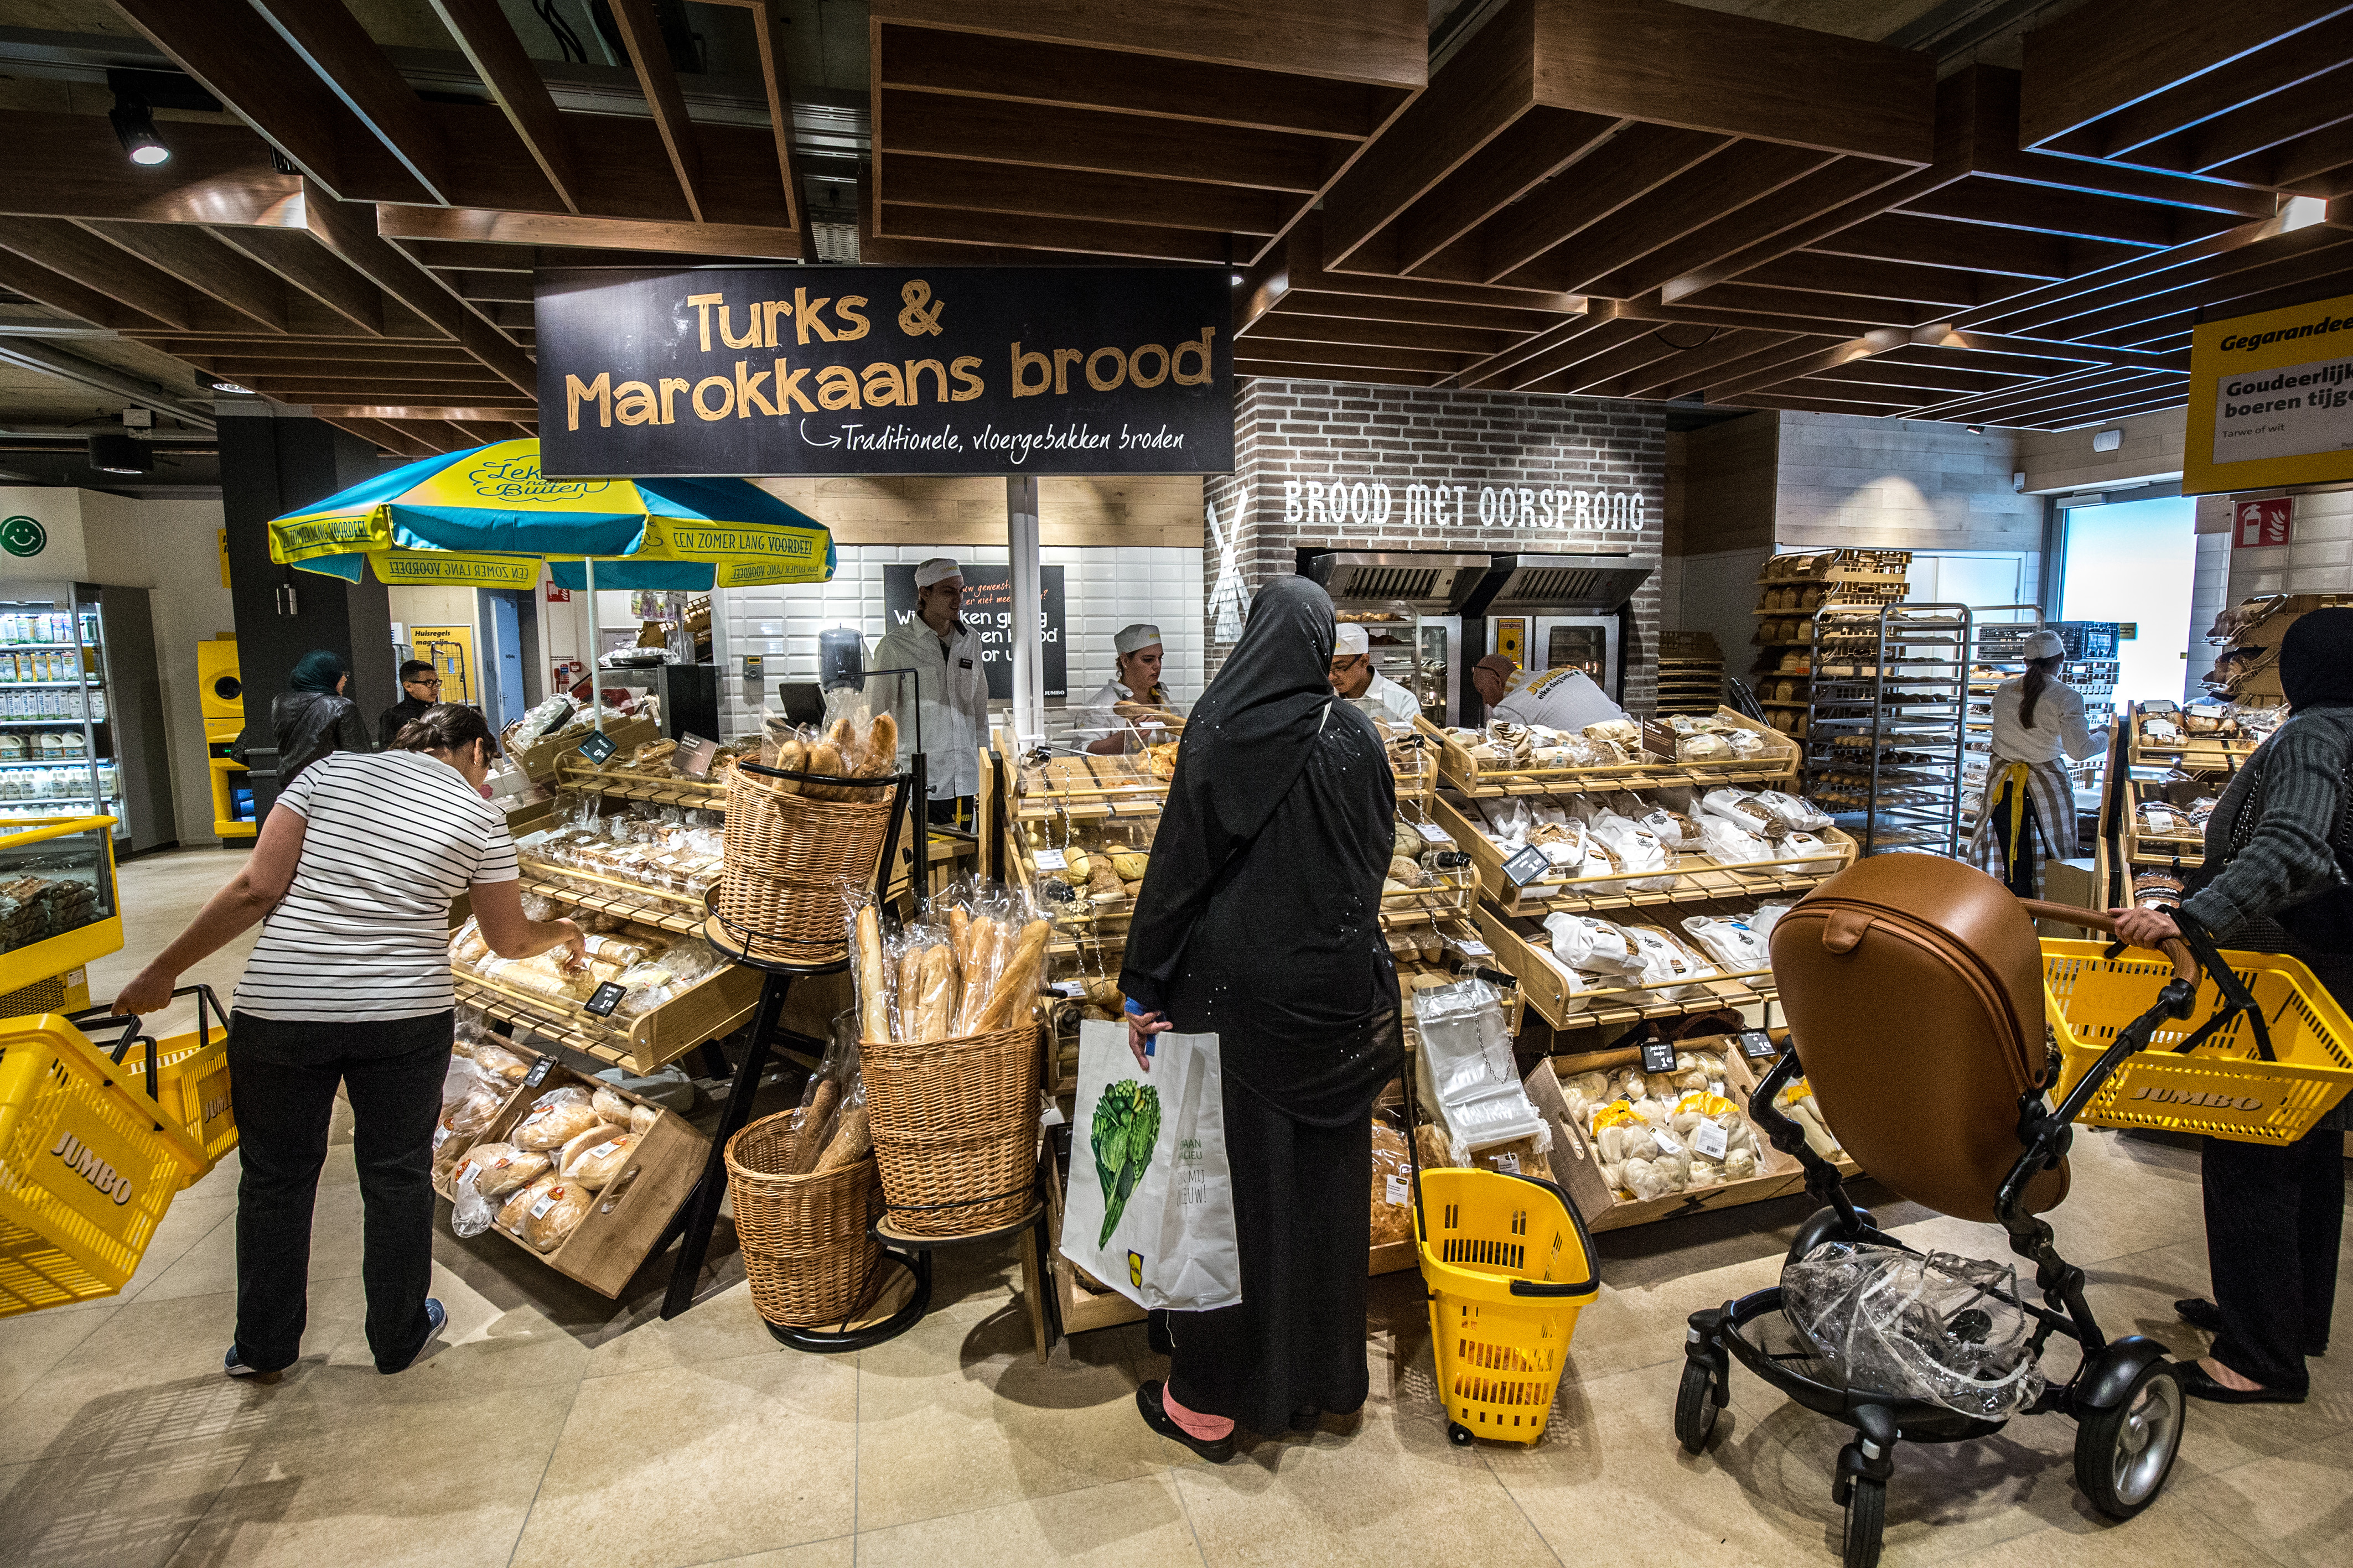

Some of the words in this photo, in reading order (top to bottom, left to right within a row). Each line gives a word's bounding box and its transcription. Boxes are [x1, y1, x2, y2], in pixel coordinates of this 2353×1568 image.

[687, 287, 870, 351] Turks
[898, 279, 945, 337] &
[566, 355, 984, 430] Marokkaans
[1011, 326, 1216, 397] brood
[2225, 397, 2301, 418] boeren
[2222, 429, 2252, 438] Tarwe
[2255, 425, 2266, 434] of
[2268, 424, 2285, 432] wit
[841, 423, 963, 451] Traditionele,
[972, 423, 1111, 464] vloergebakken
[1120, 423, 1183, 450] broden
[476, 481, 597, 496] Buiten
[1283, 480, 1391, 525] BROOD
[1404, 484, 1467, 526] MET
[1479, 486, 1644, 531] OORSPRONG
[674, 533, 694, 548] EEN
[698, 533, 735, 549] ZOMER
[739, 534, 764, 550] LANG
[768, 537, 812, 555] VOORDEEL
[975, 580, 1010, 597] gewenst
[978, 594, 992, 604] niet
[1538, 687, 1551, 700] elke
[1550, 679, 1563, 690] dag
[1559, 672, 1575, 681] beter
[2129, 1087, 2262, 1110] JUMBO
[51, 1131, 132, 1205] JUMBO
[1189, 1169, 1204, 1183] MIJ
